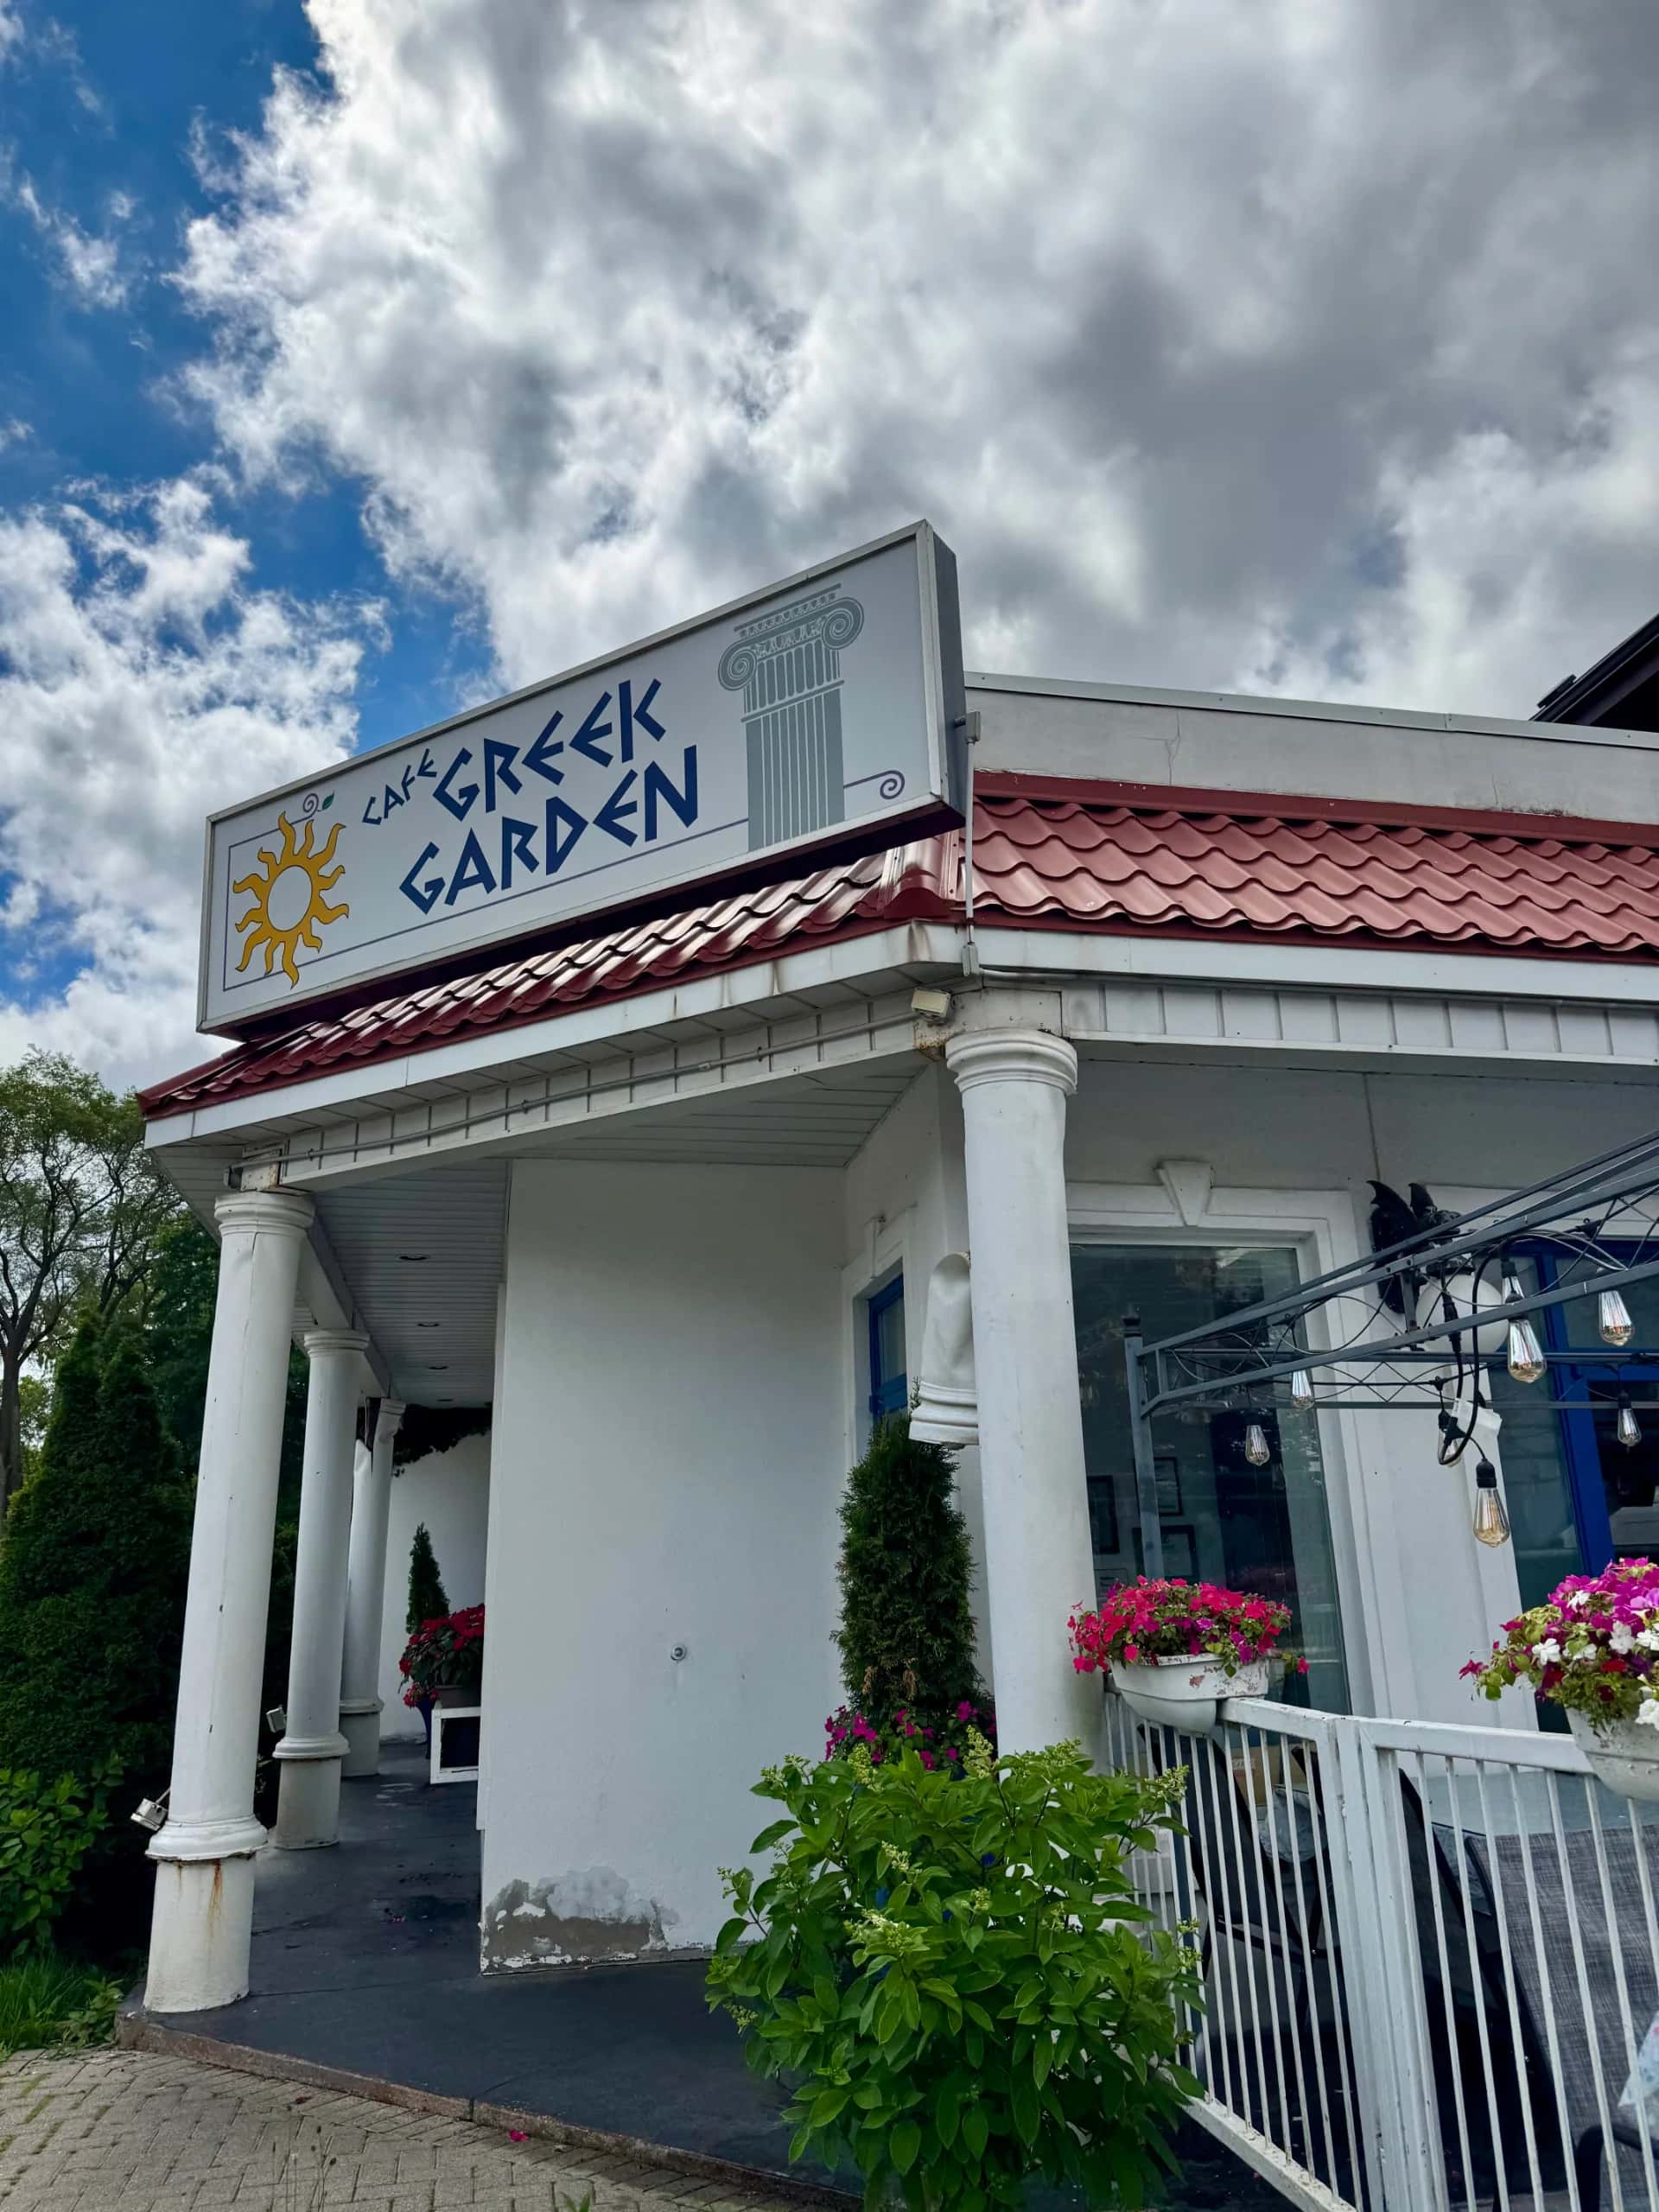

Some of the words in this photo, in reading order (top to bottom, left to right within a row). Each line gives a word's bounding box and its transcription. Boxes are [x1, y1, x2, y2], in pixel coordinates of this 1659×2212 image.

[362, 747, 437, 825] CAFE
[432, 678, 666, 822] GREEK
[398, 745, 698, 915] GARDEN
